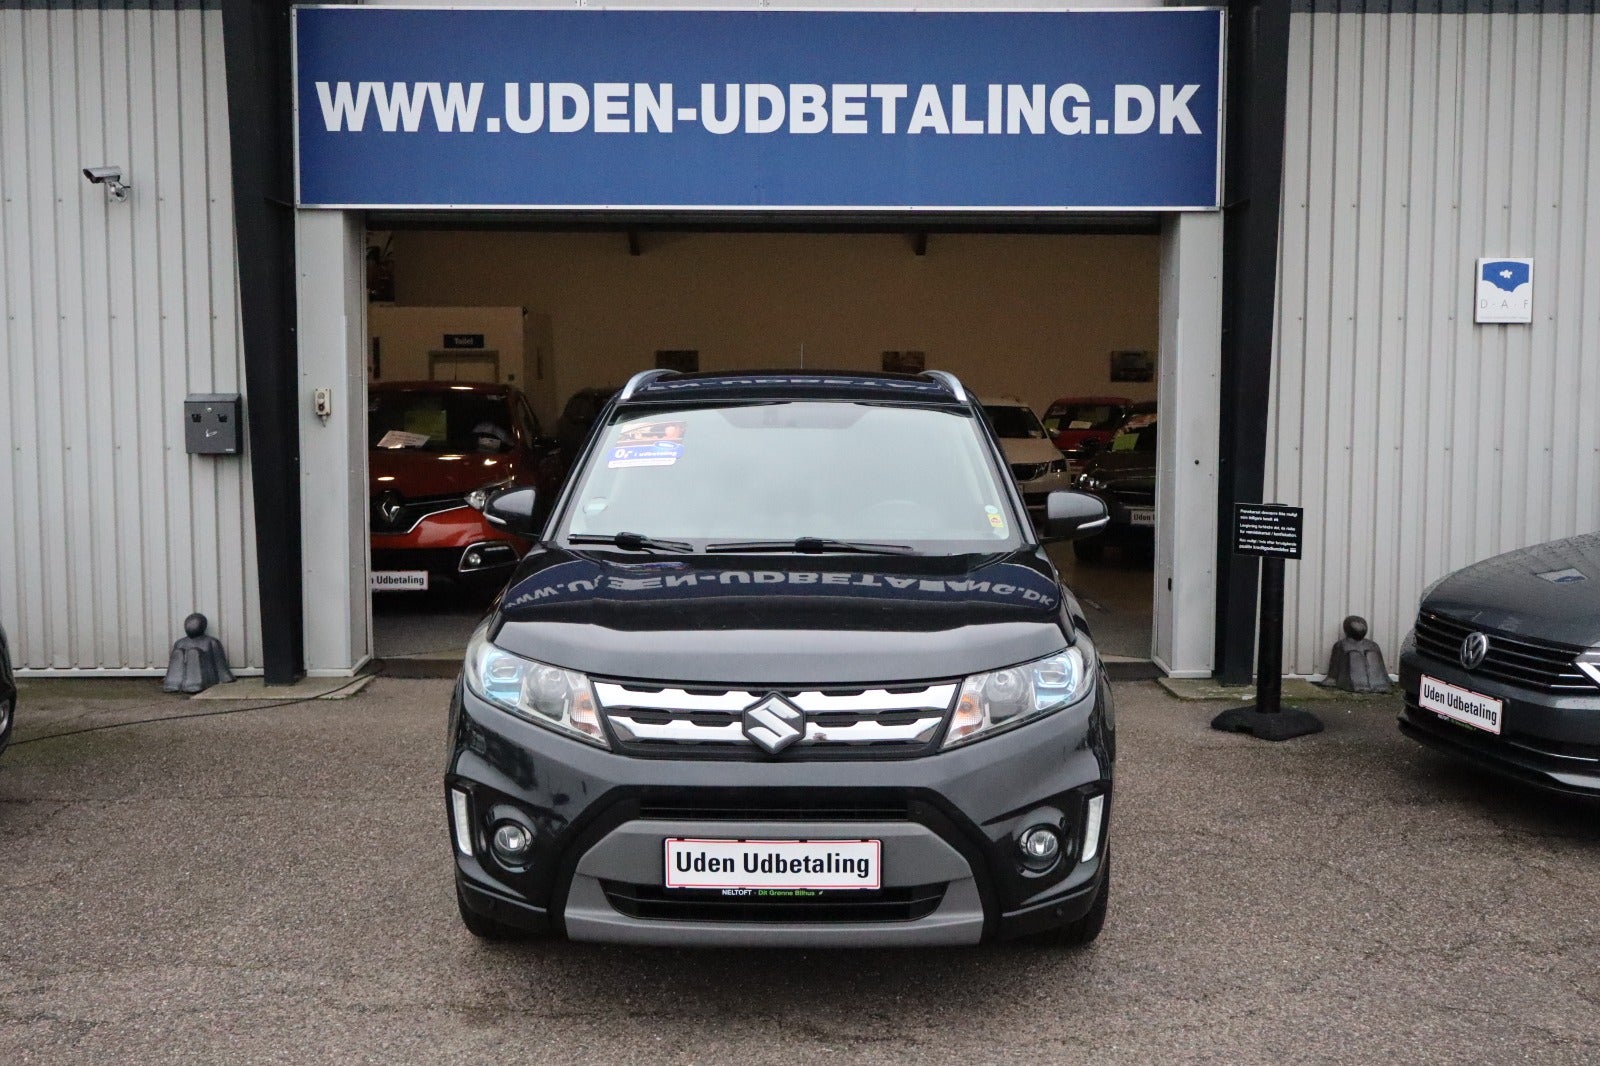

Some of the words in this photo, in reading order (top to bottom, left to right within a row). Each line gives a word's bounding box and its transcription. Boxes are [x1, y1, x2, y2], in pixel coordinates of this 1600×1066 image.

[314, 80, 1202, 136] WWW.UDEN-UDBETALING.DK
[376, 575, 424, 586] Udbetaling
[1423, 684, 1445, 704] Uden
[1447, 692, 1498, 726] Udbetaling
[676, 851, 735, 873] Uden
[743, 852, 870, 879] Udbetaling
